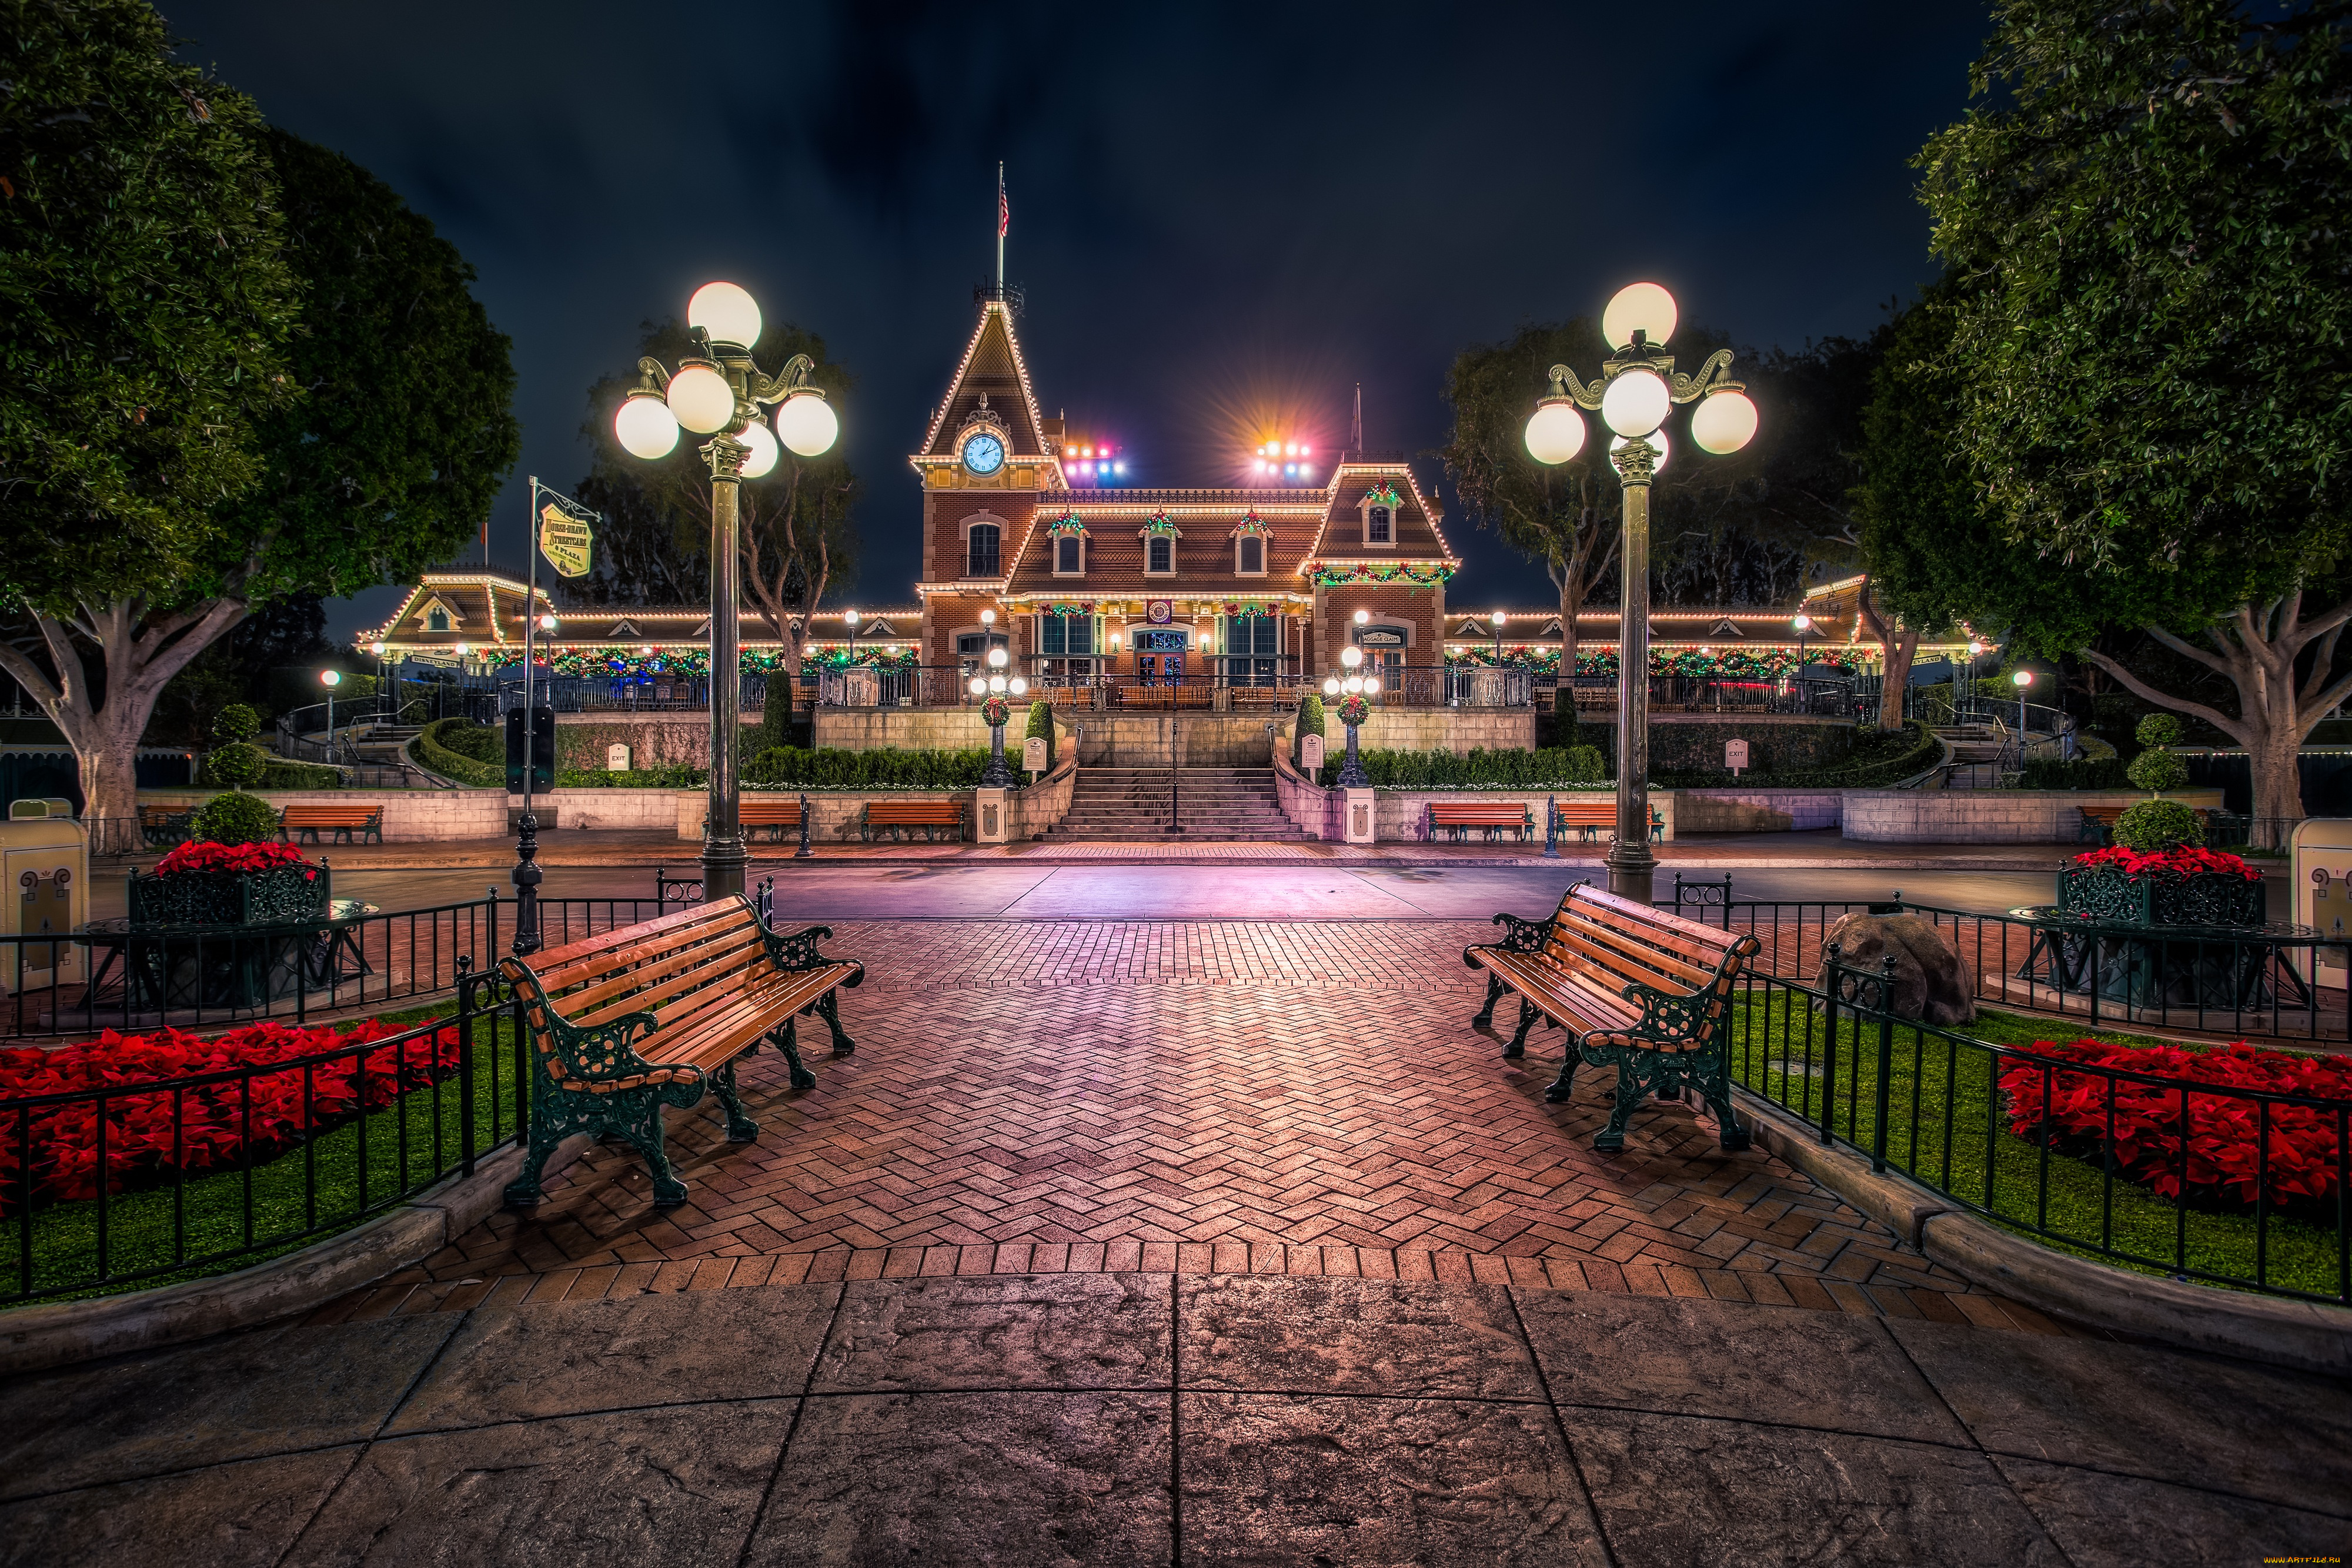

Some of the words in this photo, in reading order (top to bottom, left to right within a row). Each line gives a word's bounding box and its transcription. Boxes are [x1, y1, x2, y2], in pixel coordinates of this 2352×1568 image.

[545, 519, 587, 534] HORSE-DRAWN
[549, 532, 586, 546] STREETCARS
[560, 547, 580, 561] PLAZA
[1150, 603, 1169, 611] Disneyland
[415, 657, 455, 666] DISNEYLAND
